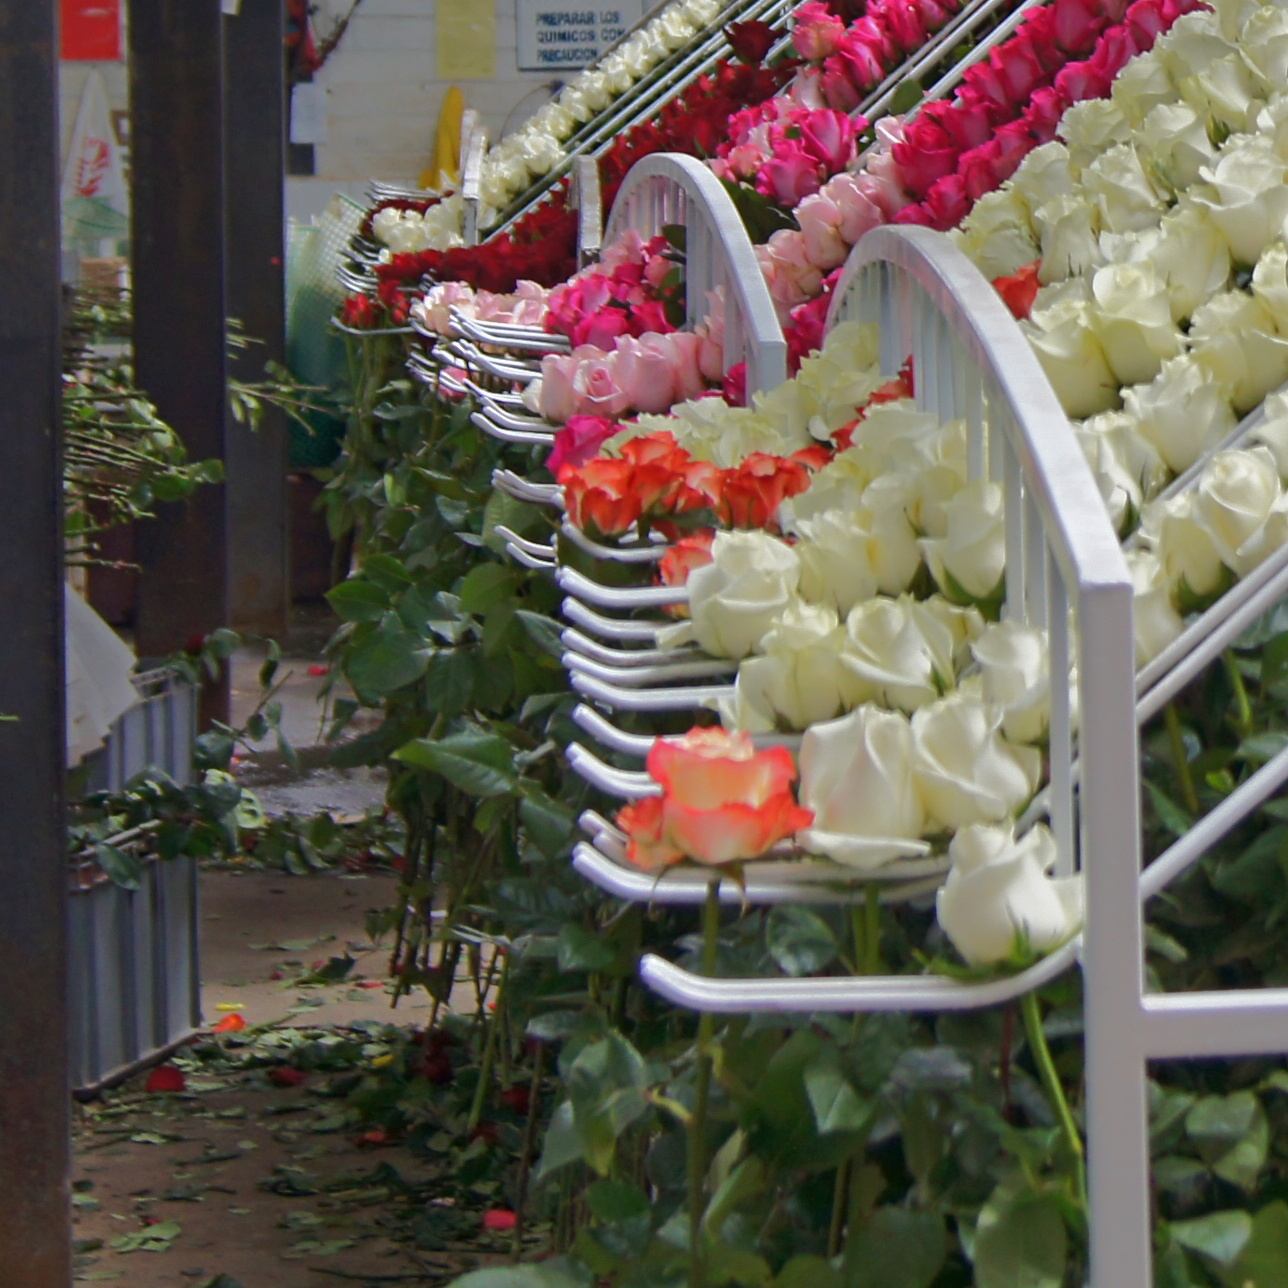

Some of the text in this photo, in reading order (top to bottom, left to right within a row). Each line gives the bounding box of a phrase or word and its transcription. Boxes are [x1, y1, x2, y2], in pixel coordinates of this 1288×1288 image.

[536, 12, 619, 26] PREPARAR LOS
[537, 30, 595, 43] QUIMICOS
[537, 48, 598, 62] PRECAUCION
